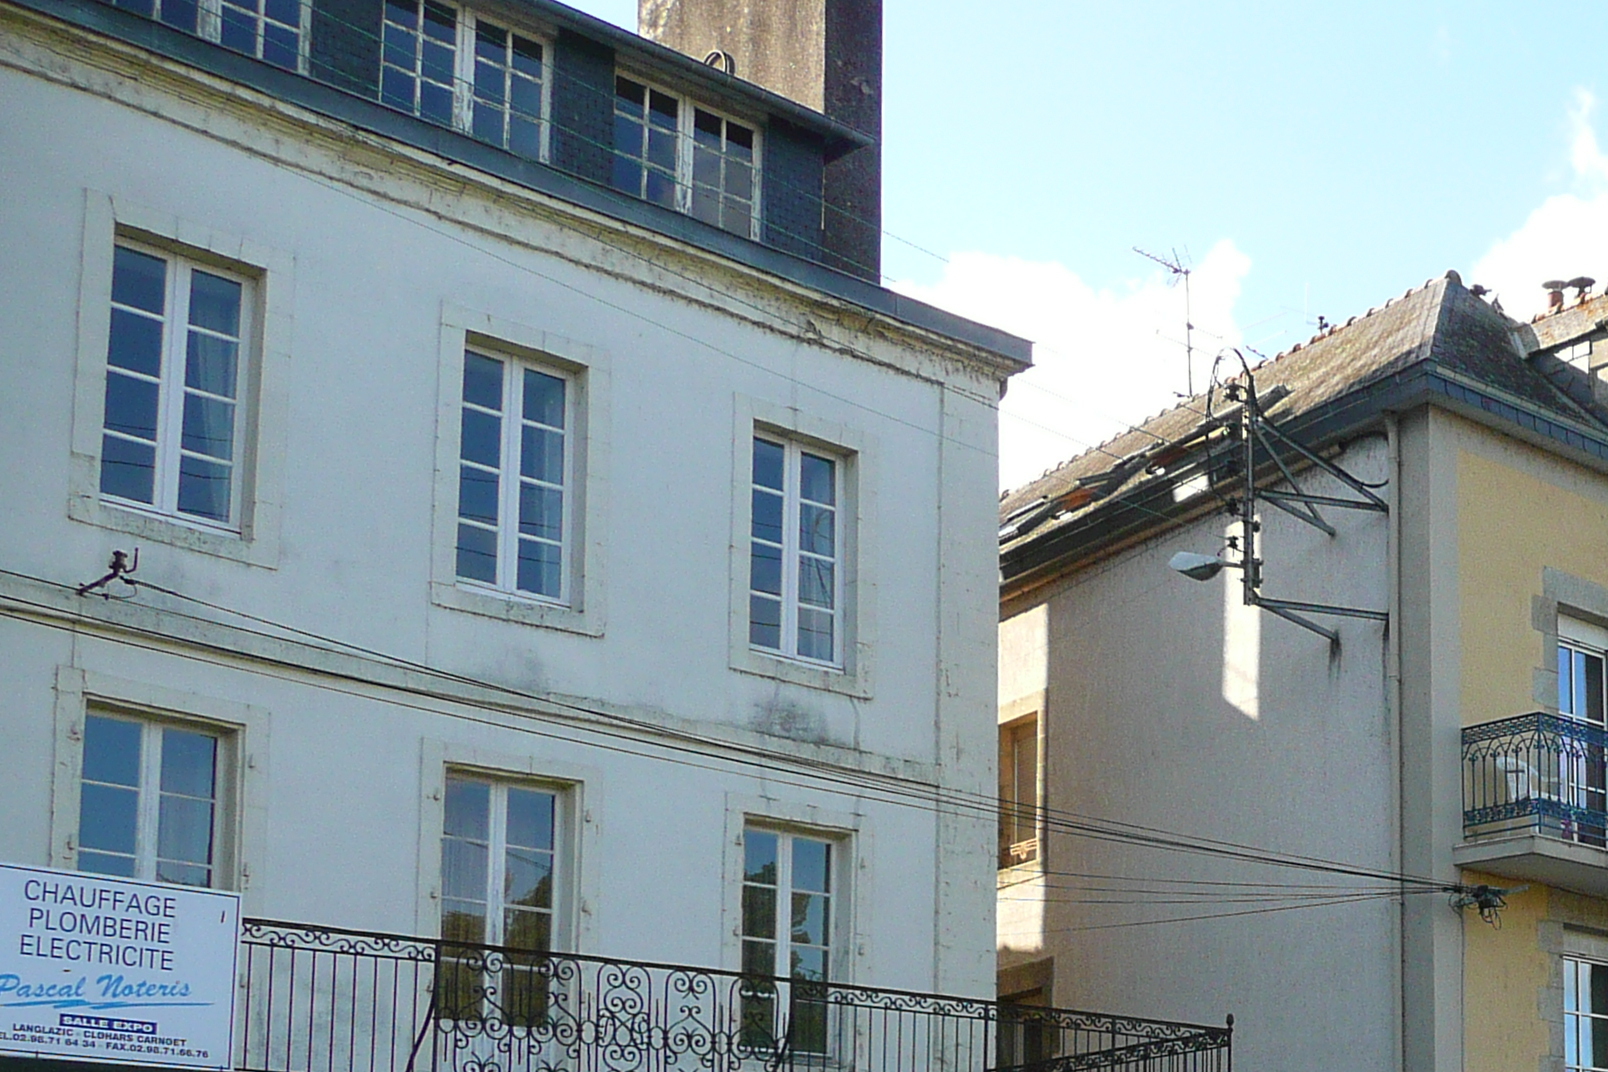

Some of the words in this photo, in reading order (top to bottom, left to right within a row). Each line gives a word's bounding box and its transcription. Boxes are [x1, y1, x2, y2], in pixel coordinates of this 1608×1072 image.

[24, 879, 176, 918] CHAUFFAGE
[28, 907, 171, 944] PLOMBERIE
[19, 933, 174, 971] ELECTRICITE
[0, 973, 87, 998] Pascal
[96, 973, 192, 998] Noteris
[12, 1023, 74, 1037] LANGLAZIC
[83, 1030, 134, 1042] CLOHARS
[136, 1035, 188, 1047] CARNOET
[62, 1016, 109, 1028] SALLE
[113, 1021, 154, 1033] EXPO
